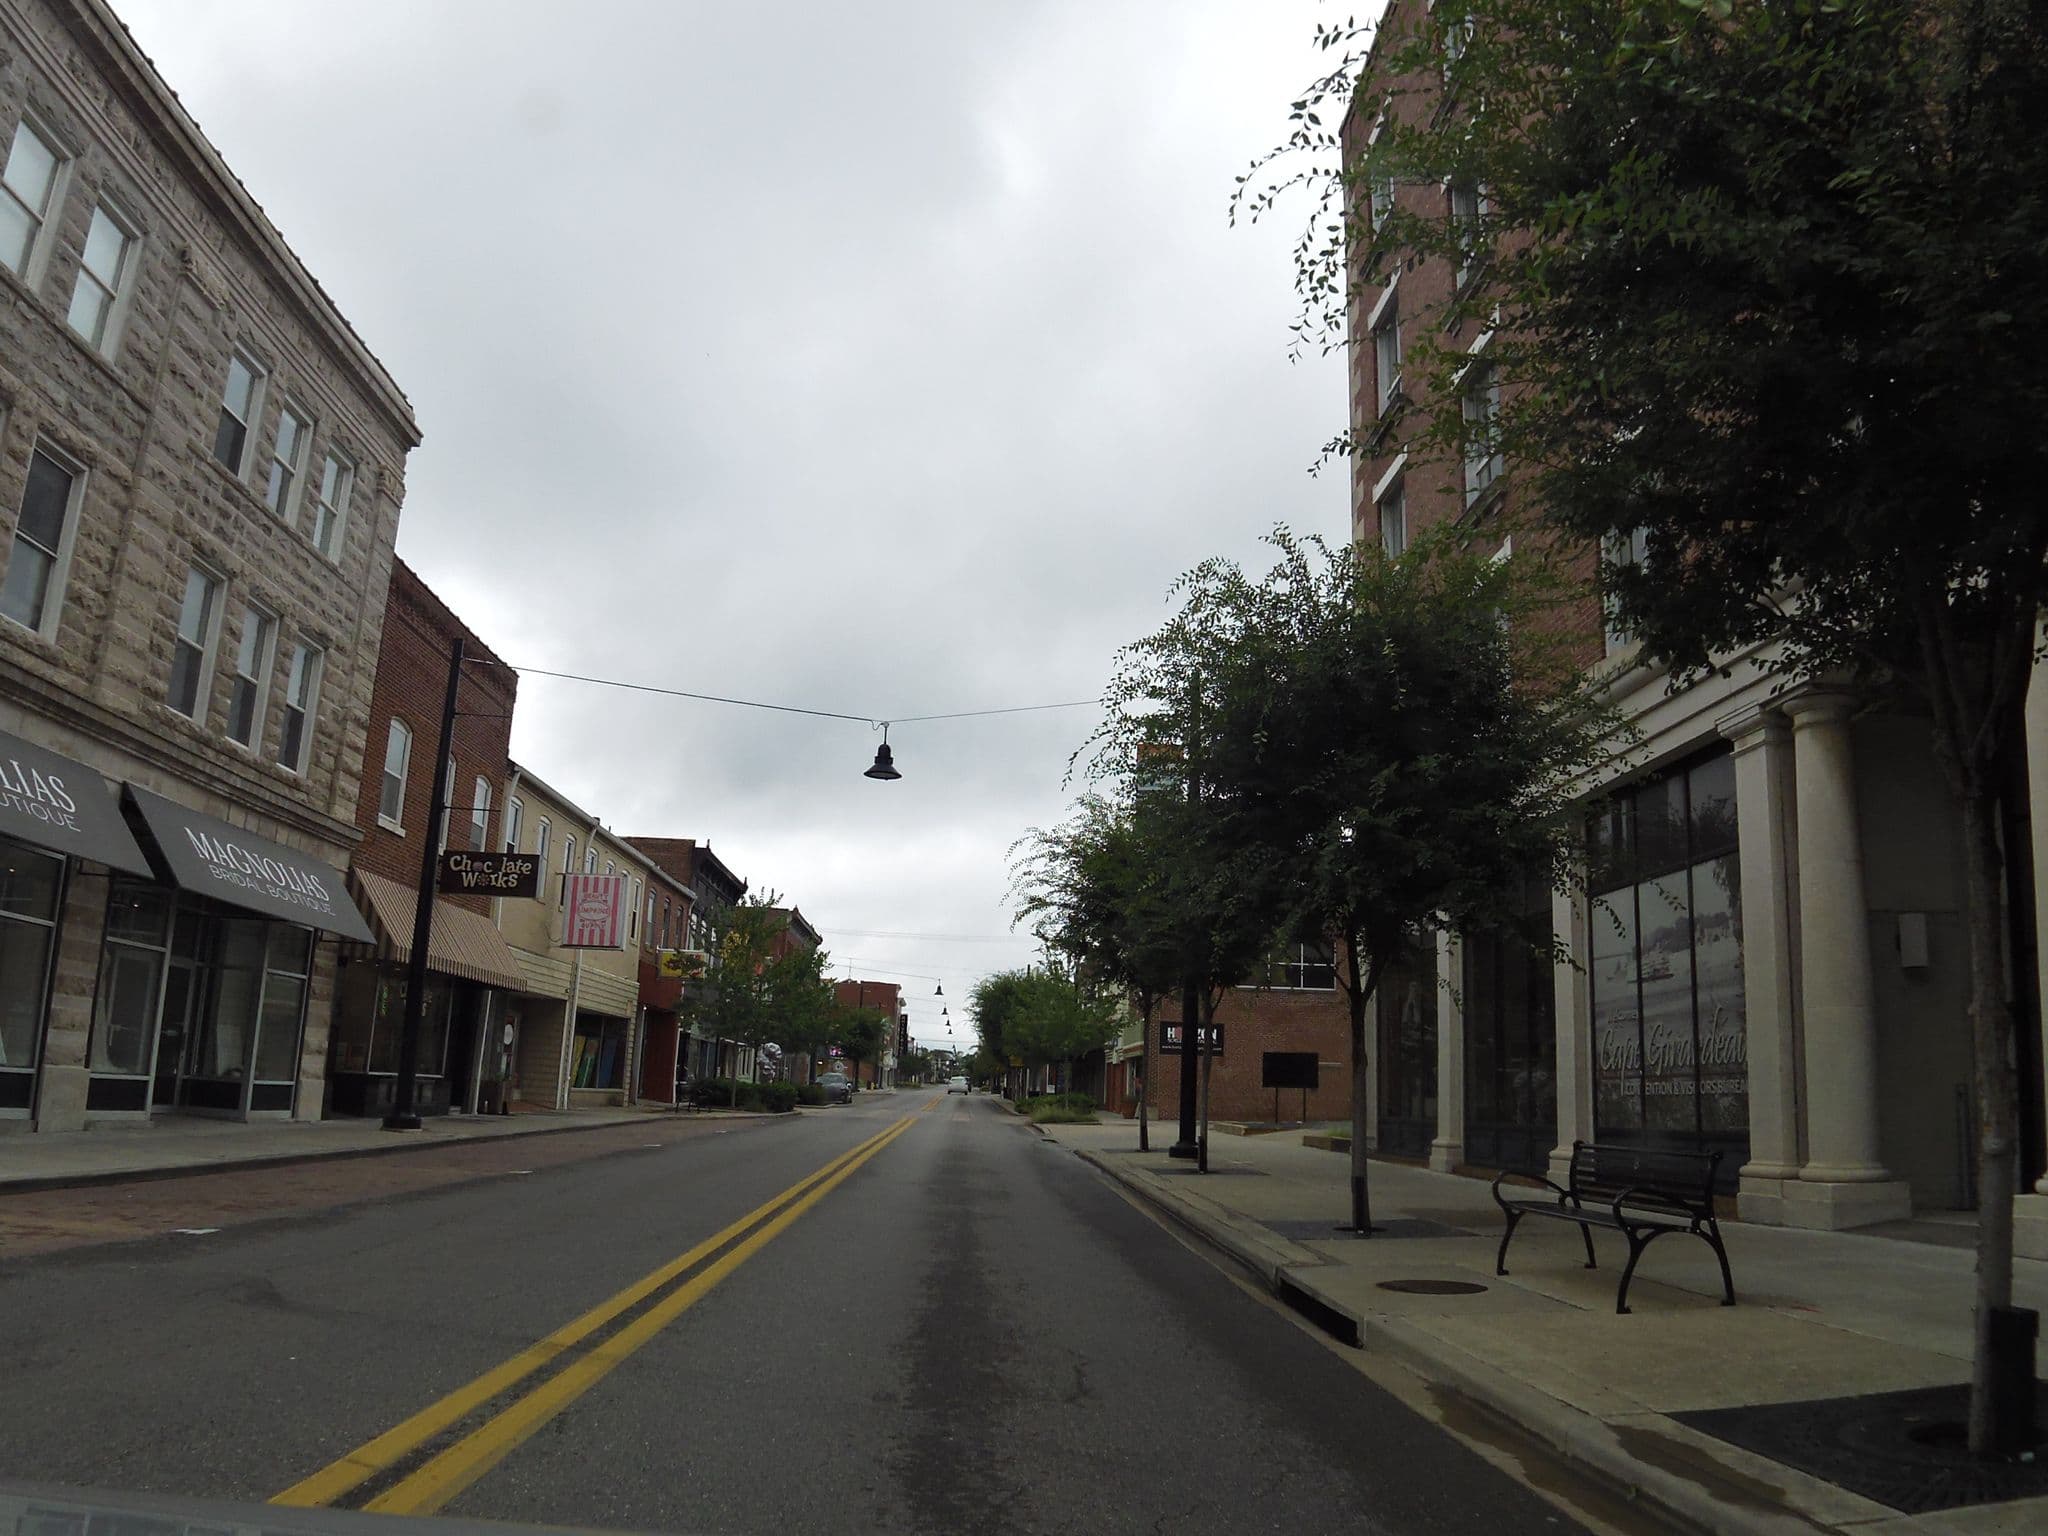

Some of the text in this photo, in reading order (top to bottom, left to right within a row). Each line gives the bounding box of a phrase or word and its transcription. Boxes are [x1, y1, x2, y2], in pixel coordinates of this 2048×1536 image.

[184, 826, 329, 902] MAGNOLIAS
[208, 864, 336, 916] BRIDAL BOUTIQUE
